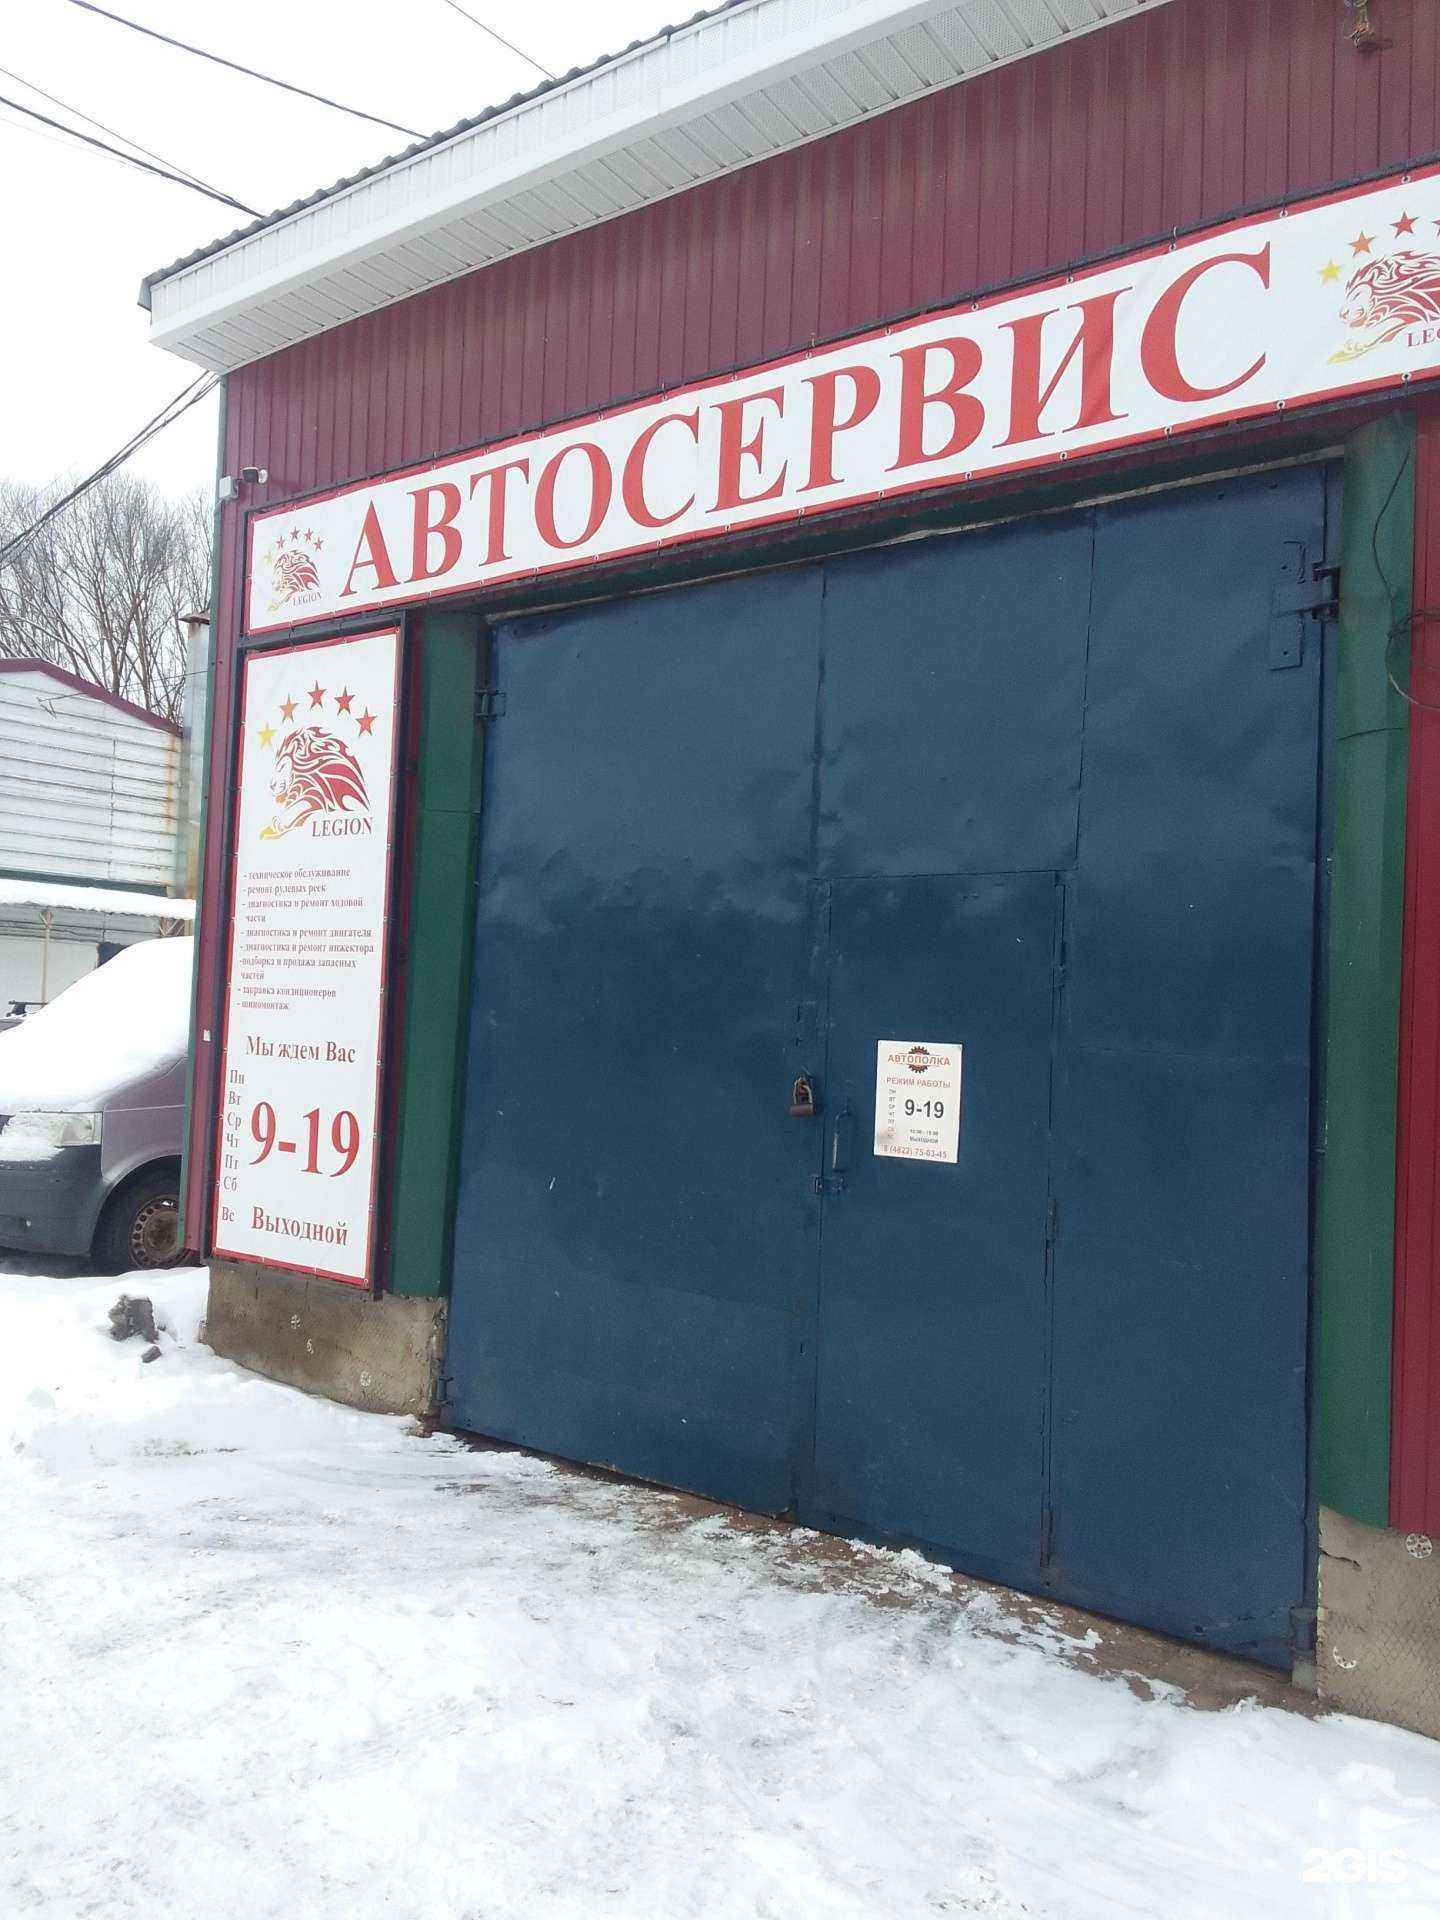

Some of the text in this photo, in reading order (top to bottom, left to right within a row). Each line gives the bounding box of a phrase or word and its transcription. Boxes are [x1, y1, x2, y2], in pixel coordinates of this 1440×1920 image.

[338, 241, 1273, 597] АВТОСЕРВИС
[291, 591, 323, 607] LEGION
[312, 817, 374, 838] LEGION
[246, 1035, 357, 1064] Мы ждем Вас
[887, 1053, 951, 1066] АВТОПОЛКА
[229, 1069, 245, 1085] Пн
[886, 1075, 951, 1088] РЕЖИМ РАБОТЫ
[228, 1090, 242, 1106] Вт
[904, 1098, 945, 1119] 9-19
[227, 1112, 242, 1131] Ср
[226, 1132, 240, 1149] Чт
[248, 1101, 361, 1178] 9-19
[225, 1154, 240, 1170] Пт
[223, 1174, 238, 1192] Сб
[221, 1206, 349, 1246] Вс Выходной
